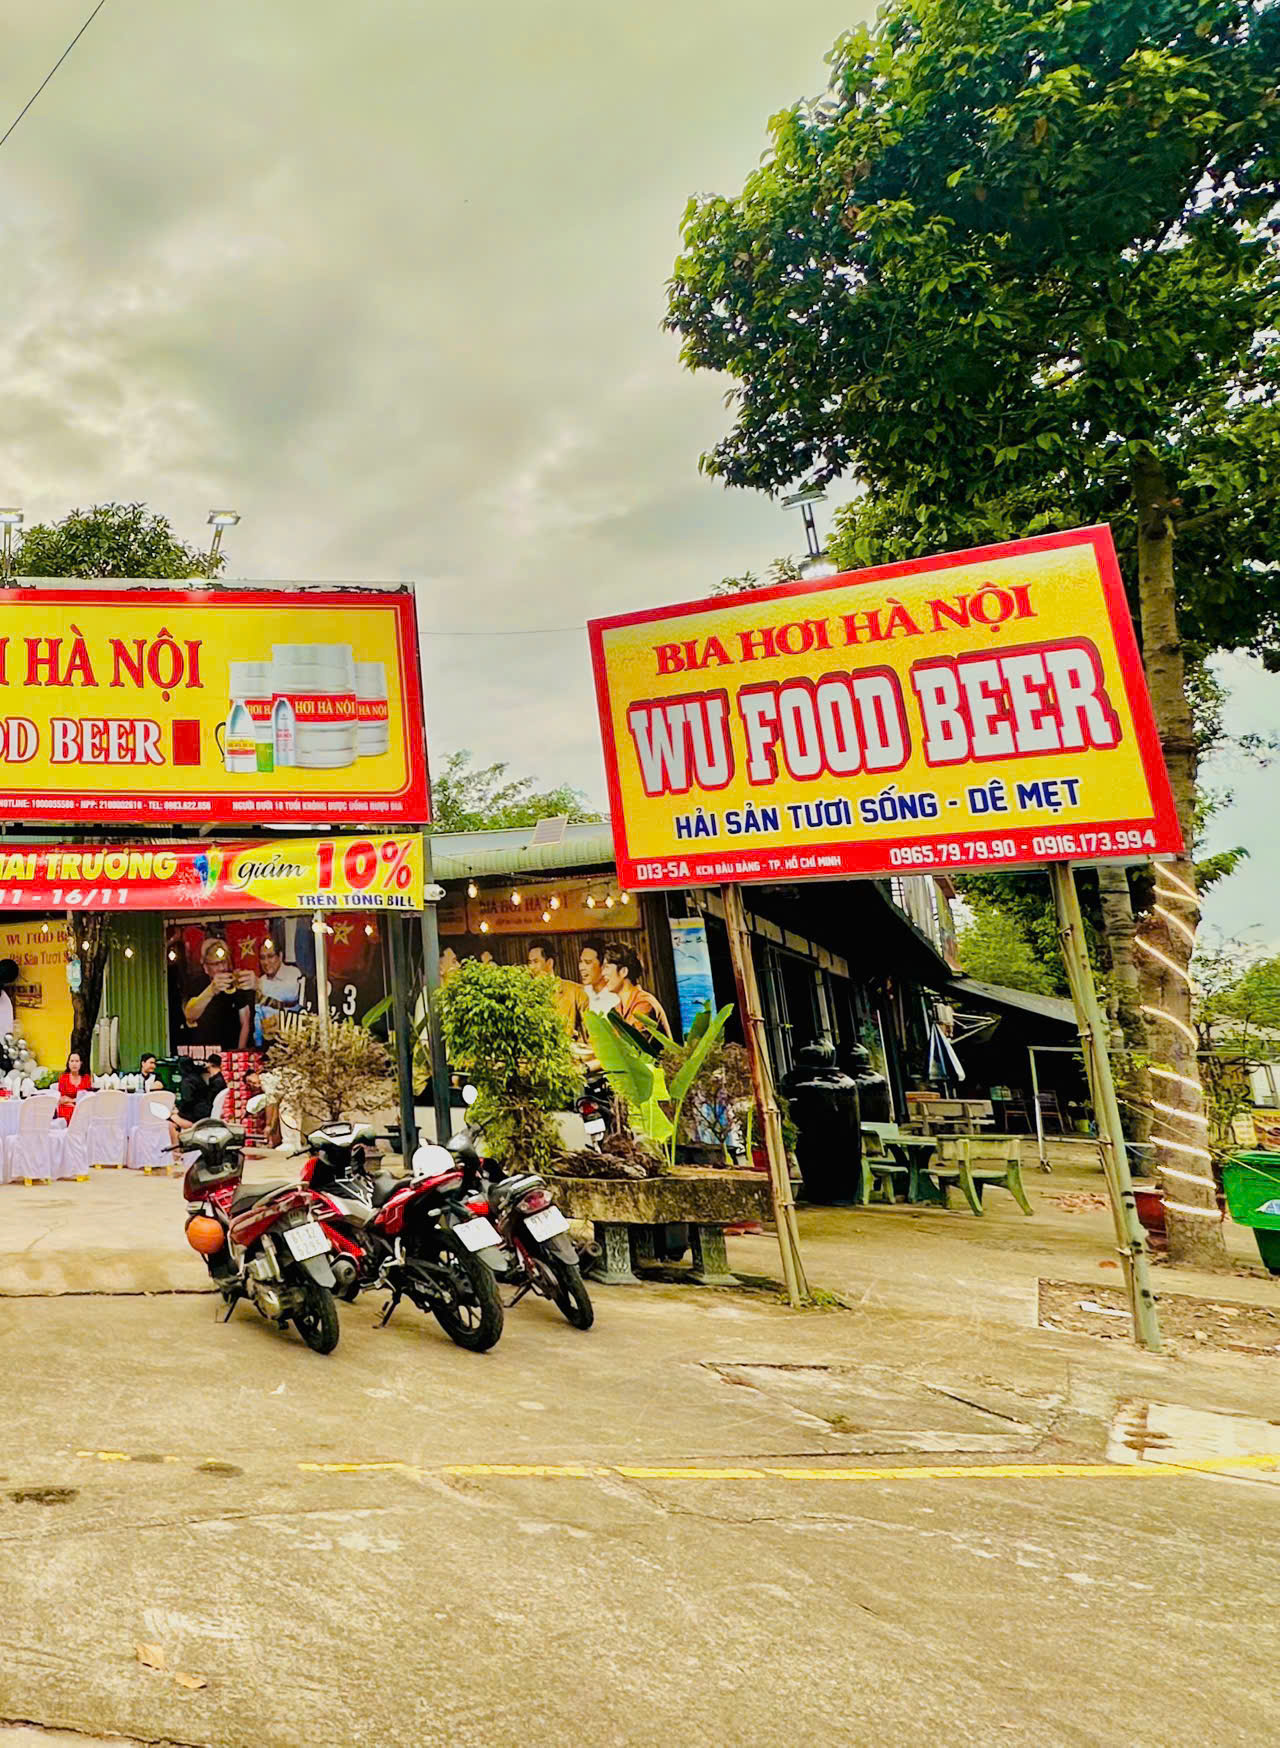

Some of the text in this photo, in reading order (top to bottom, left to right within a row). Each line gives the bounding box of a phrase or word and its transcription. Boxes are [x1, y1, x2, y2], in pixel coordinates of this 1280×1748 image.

[653, 581, 1039, 677] BIA HƠI HÀ NỘI
[24, 624, 99, 687] HÀ
[109, 627, 204, 702] NỘI
[318, 699, 332, 714] HÀ
[627, 636, 1123, 798] WU FOOD BEER
[50, 716, 166, 765] BEER
[675, 807, 718, 840] HẢI
[726, 799, 780, 837] SẢN
[787, 796, 853, 832] TƯƠI
[861, 784, 939, 824] SỐNG
[970, 778, 1006, 815] DÊ
[1015, 777, 1081, 815] MẸT
[45, 847, 178, 880] TRƯƠNG
[315, 840, 415, 890] 10%
[890, 837, 1016, 866] 0965.79.79.90
[1032, 829, 1157, 857] 0916.173.994
[52, 888, 129, 906] 16/11
[297, 891, 338, 906] TRÊN
[387, 895, 415, 907] BILL
[343, 984, 357, 1016] 3
